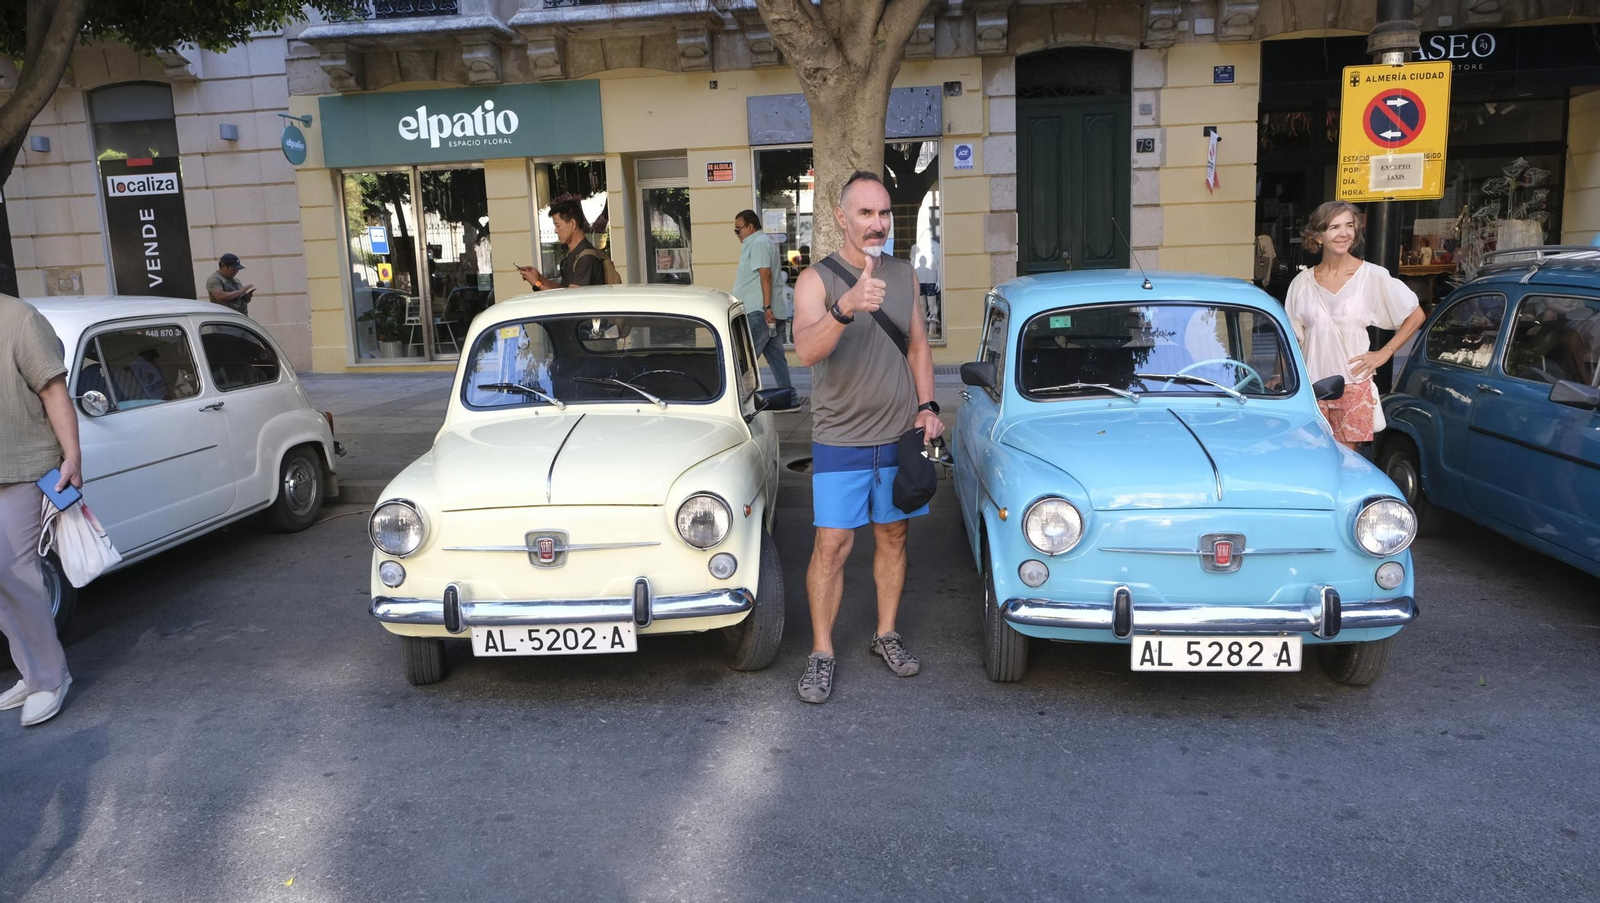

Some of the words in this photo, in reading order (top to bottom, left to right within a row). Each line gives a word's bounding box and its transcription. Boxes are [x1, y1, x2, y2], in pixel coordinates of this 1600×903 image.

[1365, 69, 1407, 83] ALMERÍA
[1410, 72, 1445, 81] CIUDAD
[398, 99, 519, 149] elpatio
[448, 139, 481, 148] ESPACIO
[484, 138, 513, 146] FLORAL
[1137, 139, 1154, 152] 79
[714, 163, 733, 171] ALQUILA
[111, 176, 176, 194] localiza
[1342, 177, 1358, 186] DÍA:
[138, 208, 164, 289] VENDE
[160, 329, 174, 337] 870
[1139, 640, 1174, 667] AL
[1186, 641, 1265, 668] 5282
[1275, 641, 1293, 667] A
